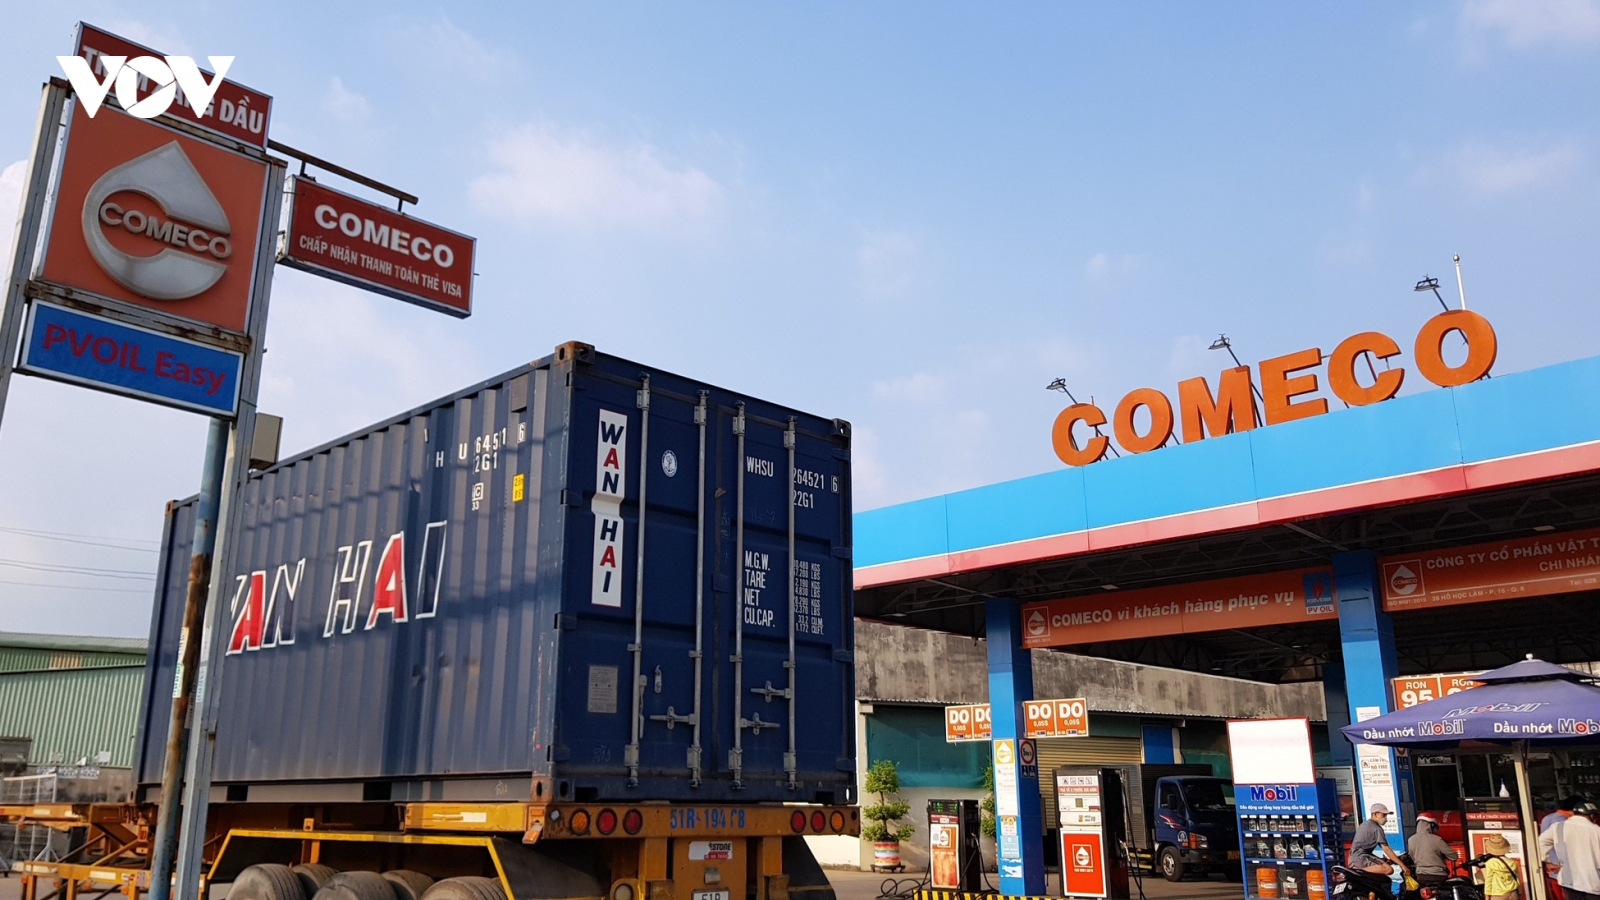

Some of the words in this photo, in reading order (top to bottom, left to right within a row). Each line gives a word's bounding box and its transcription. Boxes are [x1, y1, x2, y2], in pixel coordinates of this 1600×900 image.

[219, 95, 264, 134] DẦU
[99, 202, 232, 260] COMECO
[314, 204, 454, 268] COMECO
[300, 234, 328, 255] CHẤP
[330, 245, 358, 265] NHẬN
[360, 253, 392, 276] THANH
[394, 266, 419, 285] TOÁN
[421, 273, 439, 291] THẺ
[442, 280, 462, 298] VISA
[43, 323, 147, 373] PVOIL
[154, 350, 226, 396] Easy
[1051, 309, 1497, 467] COMECO
[600, 420, 625, 494] WAN
[746, 456, 774, 478] WHSU
[793, 467, 825, 489] 264521
[831, 476, 839, 492] 6
[793, 489, 814, 509] 22G1
[599, 519, 619, 593] HAI
[745, 550, 771, 571] M.G.W.
[1426, 555, 1465, 570] CÔNG
[1468, 553, 1486, 565] TY
[1556, 538, 1586, 554] VẬT
[793, 560, 809, 570] 0.480
[793, 569, 809, 578] 7.200
[811, 571, 820, 581] LBS
[1539, 560, 1563, 572] CHI
[322, 520, 447, 638] HAI
[745, 569, 766, 588] TARE
[744, 588, 760, 606] NET
[794, 596, 809, 606] 8.290
[811, 589, 820, 599] LBS
[794, 605, 809, 615] 2.370
[811, 607, 820, 616] LBS
[1052, 608, 1113, 628] COMECO
[1117, 606, 1130, 621] vì
[1133, 601, 1180, 618] khách
[1184, 599, 1223, 614] hàng
[1228, 592, 1269, 612] phục
[1274, 590, 1295, 607] vụ
[1319, 605, 1333, 613] OIL
[1405, 681, 1427, 690] RON
[1451, 678, 1474, 687] RON
[1401, 689, 1435, 708] 95
[949, 709, 970, 725] DO
[1028, 703, 1052, 720] DO
[1058, 701, 1084, 719] DO
[1441, 702, 1542, 719] Mobil
[1363, 728, 1385, 740] Dầu
[1388, 726, 1415, 738] nhớt
[1418, 719, 1465, 736] Mobil
[1493, 720, 1518, 734] Dầu
[1522, 722, 1553, 734] nhớt
[1557, 717, 1600, 735] Mob
[1250, 785, 1298, 801] Mobil
